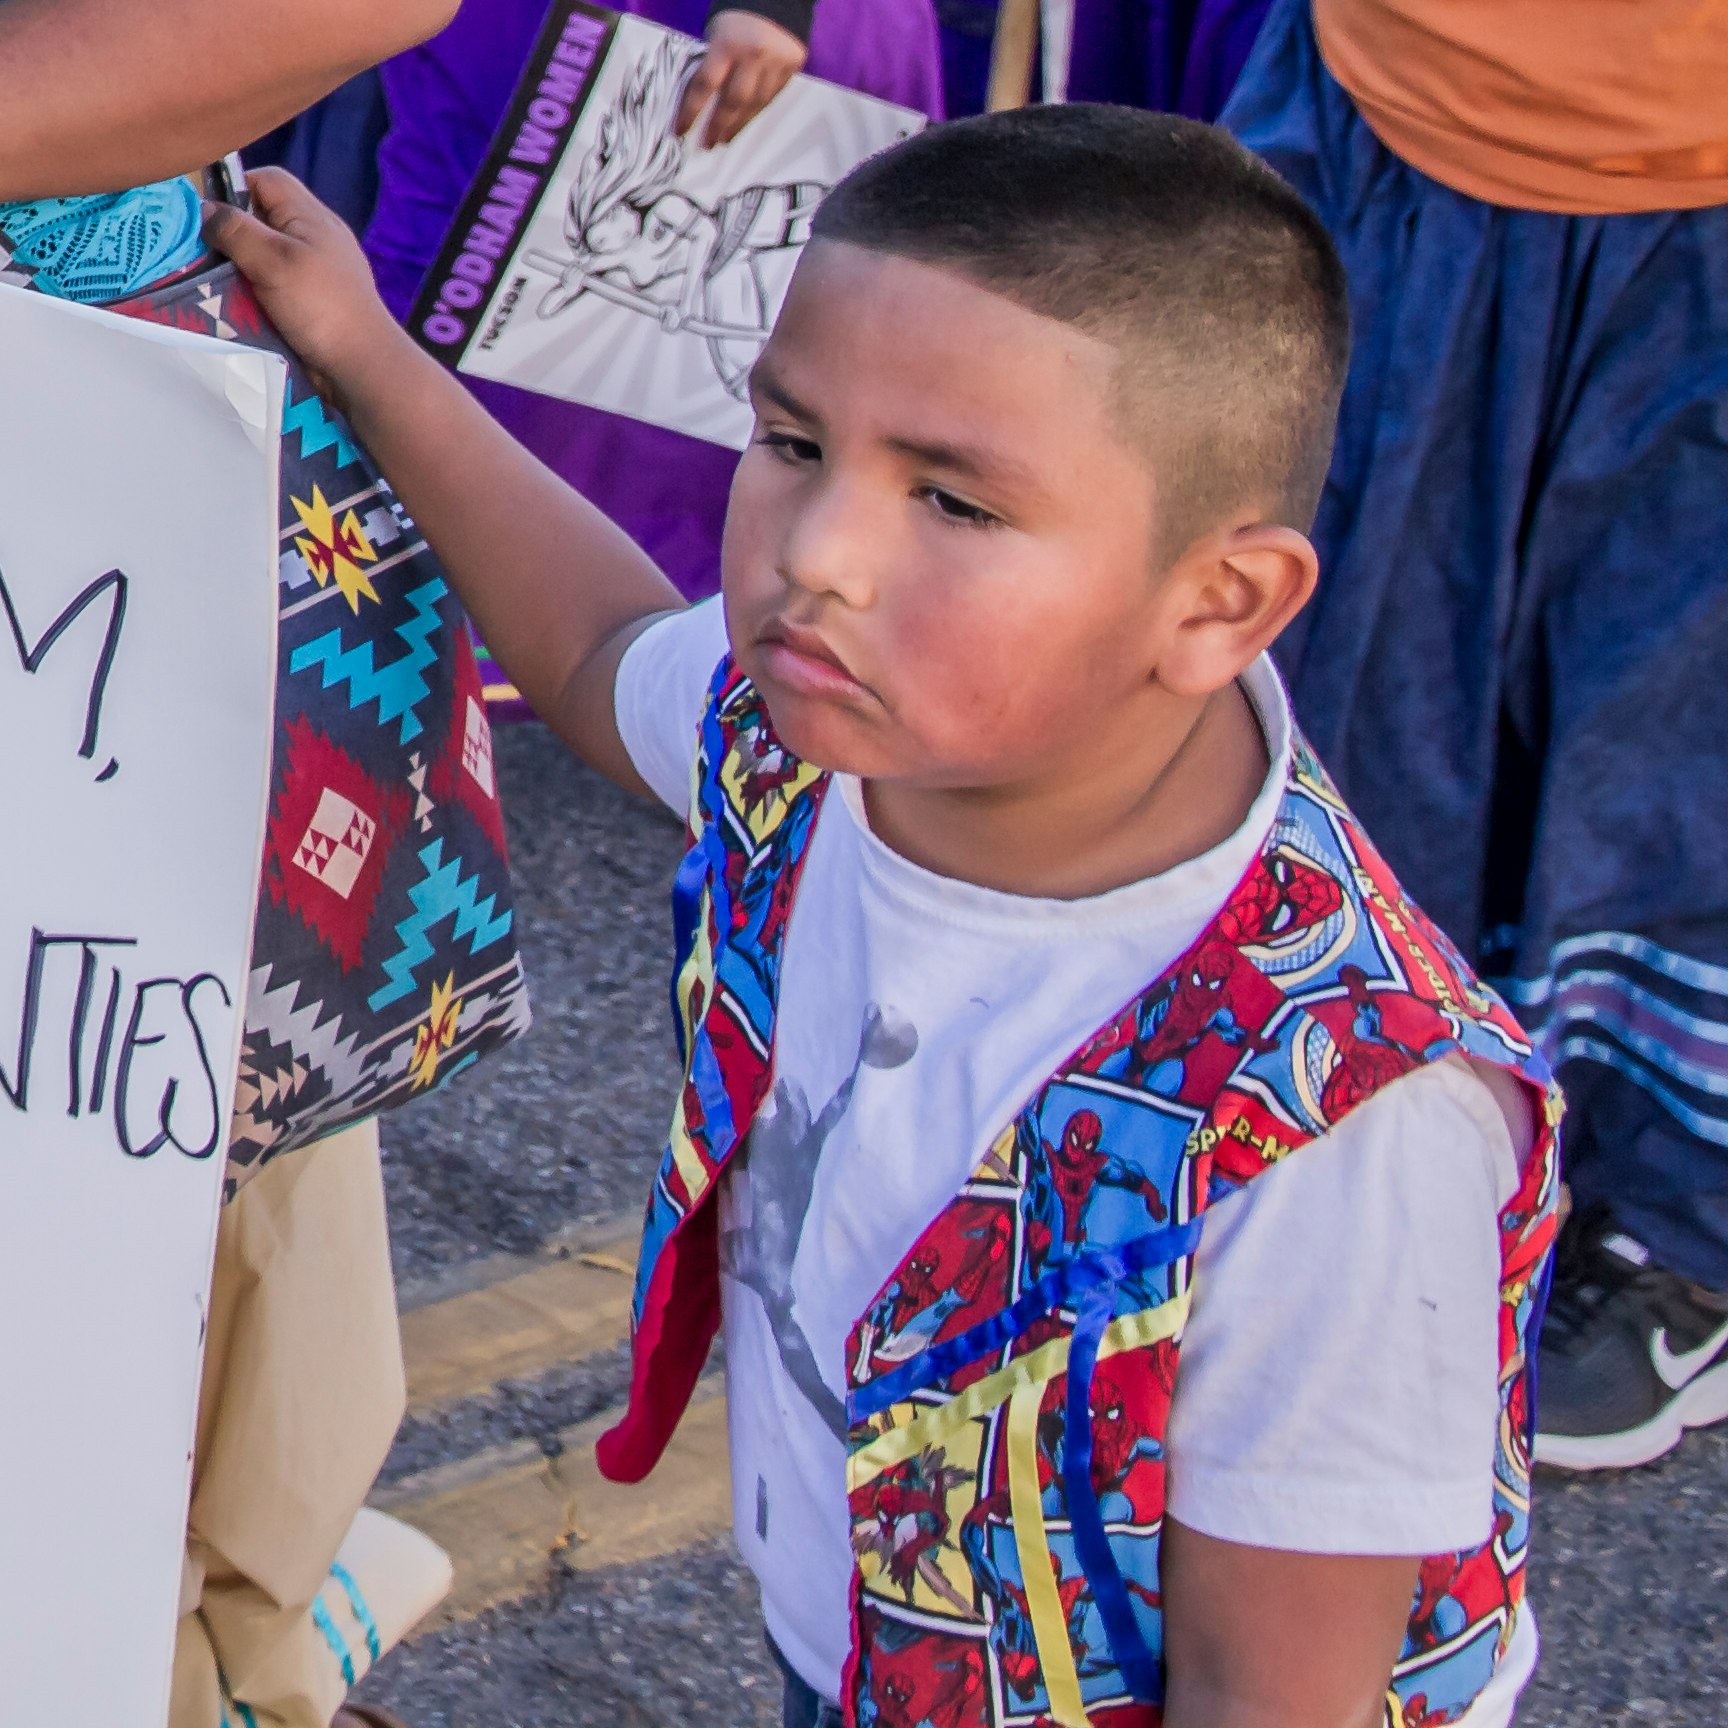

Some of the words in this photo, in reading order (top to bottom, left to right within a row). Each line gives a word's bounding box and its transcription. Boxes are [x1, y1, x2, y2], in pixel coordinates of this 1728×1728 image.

[422, 165, 541, 346] O'ODHAM
[508, 11, 608, 172] WOMEN
[478, 275, 528, 352] TUCSON
